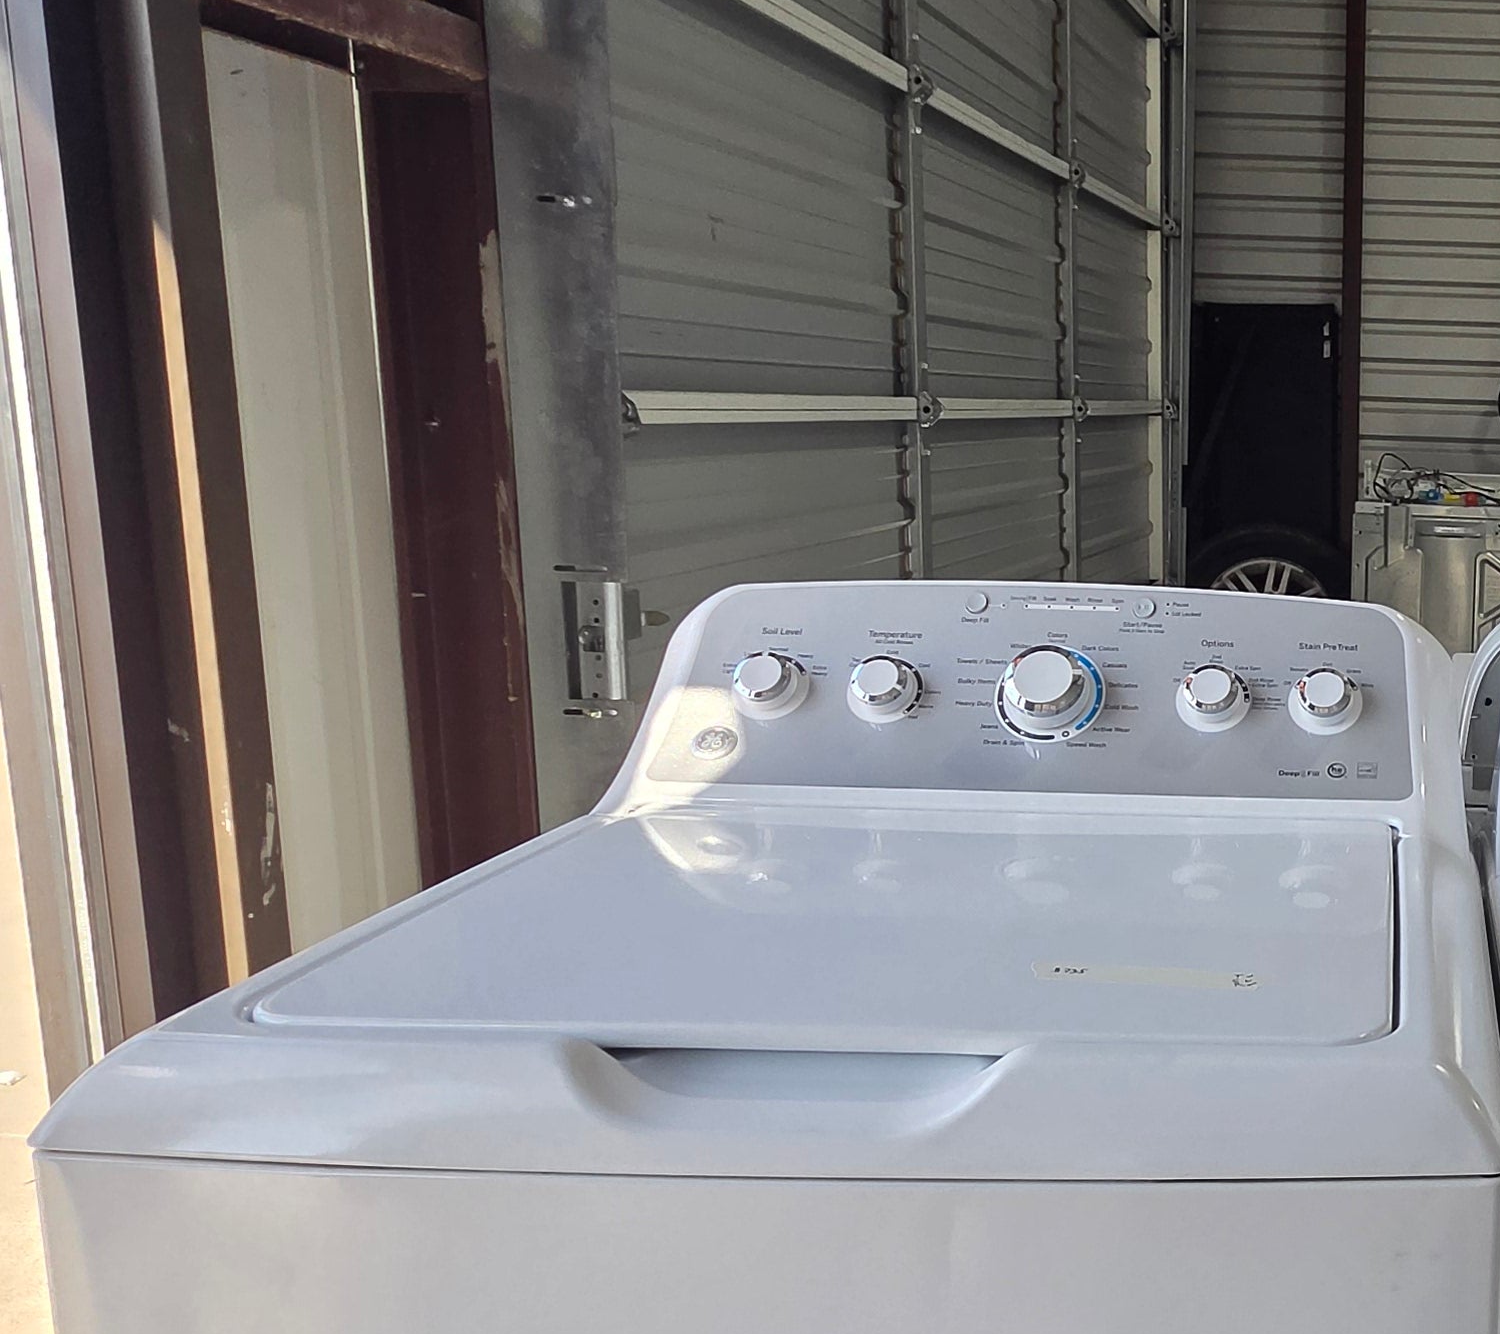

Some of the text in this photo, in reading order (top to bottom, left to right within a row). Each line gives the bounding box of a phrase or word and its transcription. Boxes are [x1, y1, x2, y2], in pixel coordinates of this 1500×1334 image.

[761, 627, 803, 636] Soil Level
[868, 630, 923, 640] Temperature
[1201, 639, 1234, 648] Options
[1299, 642, 1321, 650] Stain
[955, 700, 975, 708] Heavy
